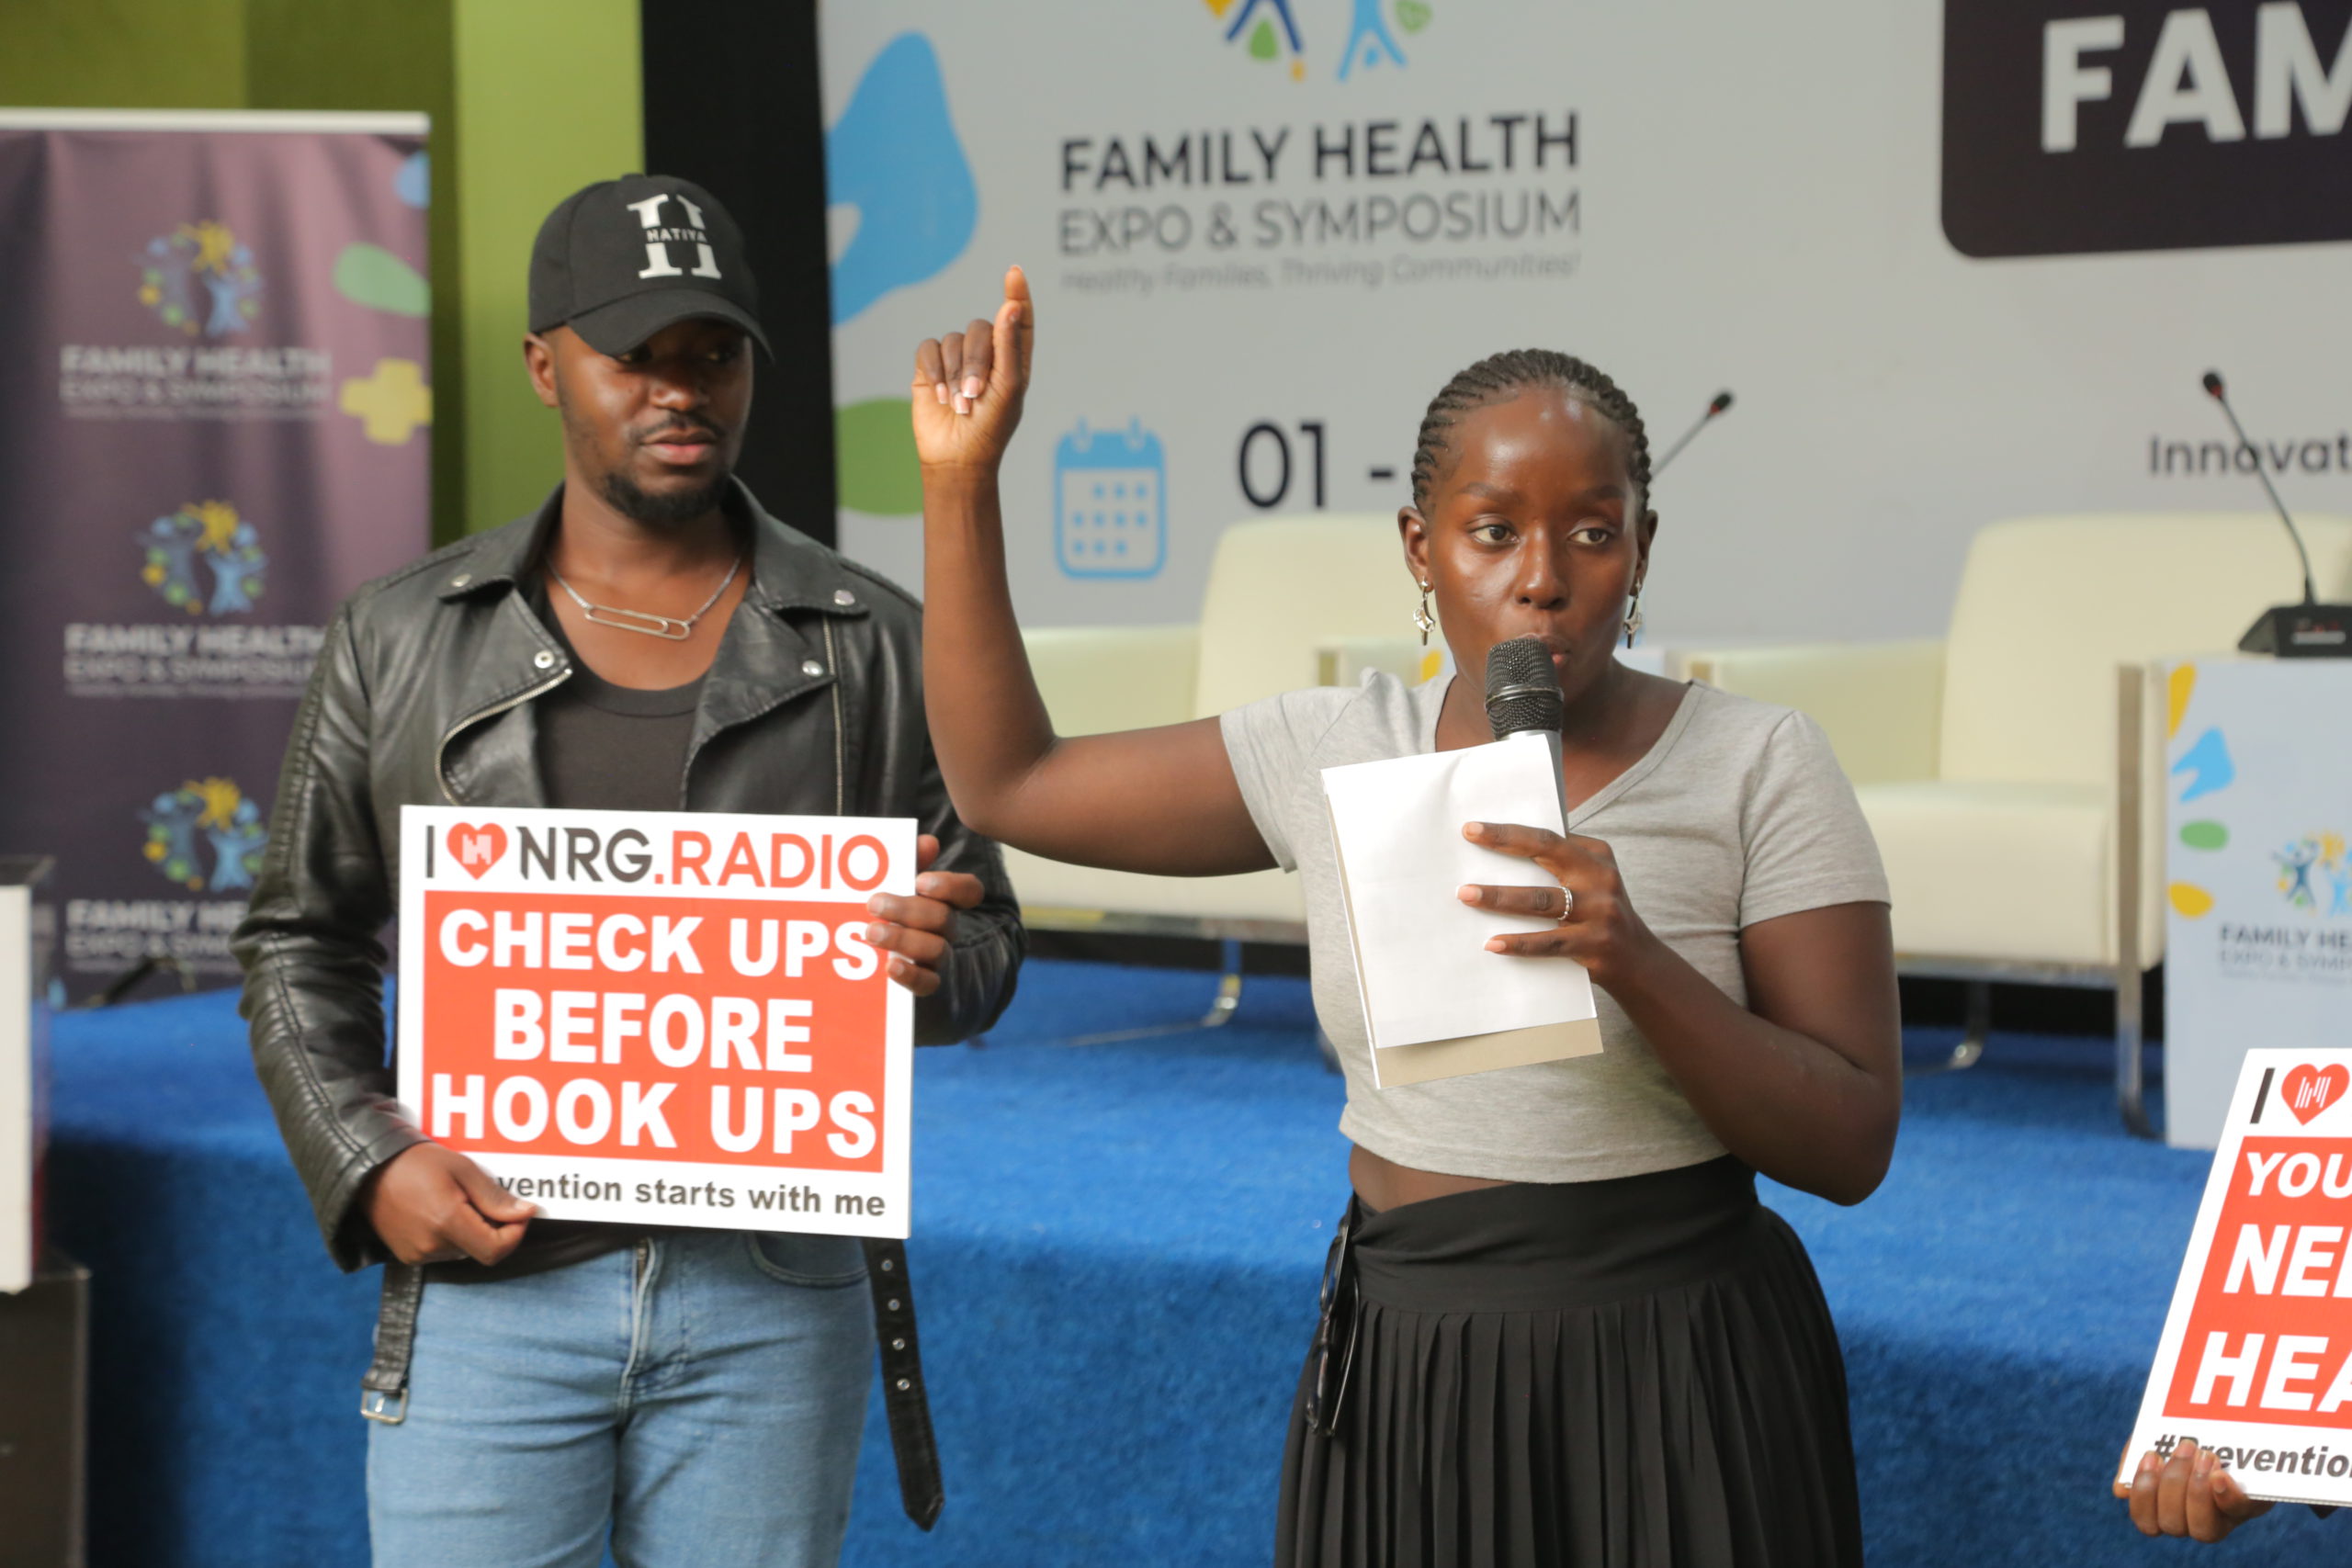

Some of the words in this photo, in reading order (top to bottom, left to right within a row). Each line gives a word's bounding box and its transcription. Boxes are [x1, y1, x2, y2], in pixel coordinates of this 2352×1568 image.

[2041, 2, 2352, 154] FAM
[1061, 129, 1289, 190] FAMILY
[1314, 111, 1578, 179] HEALTH
[1058, 204, 1193, 256] EXPO
[1205, 202, 1239, 252] &
[1253, 189, 1580, 250] SYMPOSIUM
[1238, 419, 1329, 510] 01
[516, 826, 889, 892] NRG.RADIO
[439, 908, 705, 975] CHECK
[729, 917, 879, 981] UPS
[2220, 922, 2311, 947] FAMILY
[492, 987, 814, 1074] BEFORE
[431, 1072, 678, 1148] HOOK
[709, 1084, 877, 1159] UPS
[497, 1173, 622, 1201] vention
[635, 1178, 736, 1208] starts
[748, 1183, 821, 1213] with
[833, 1193, 886, 1217] me
[2245, 1151, 2352, 1200] YOU
[2222, 1223, 2352, 1299] NE
